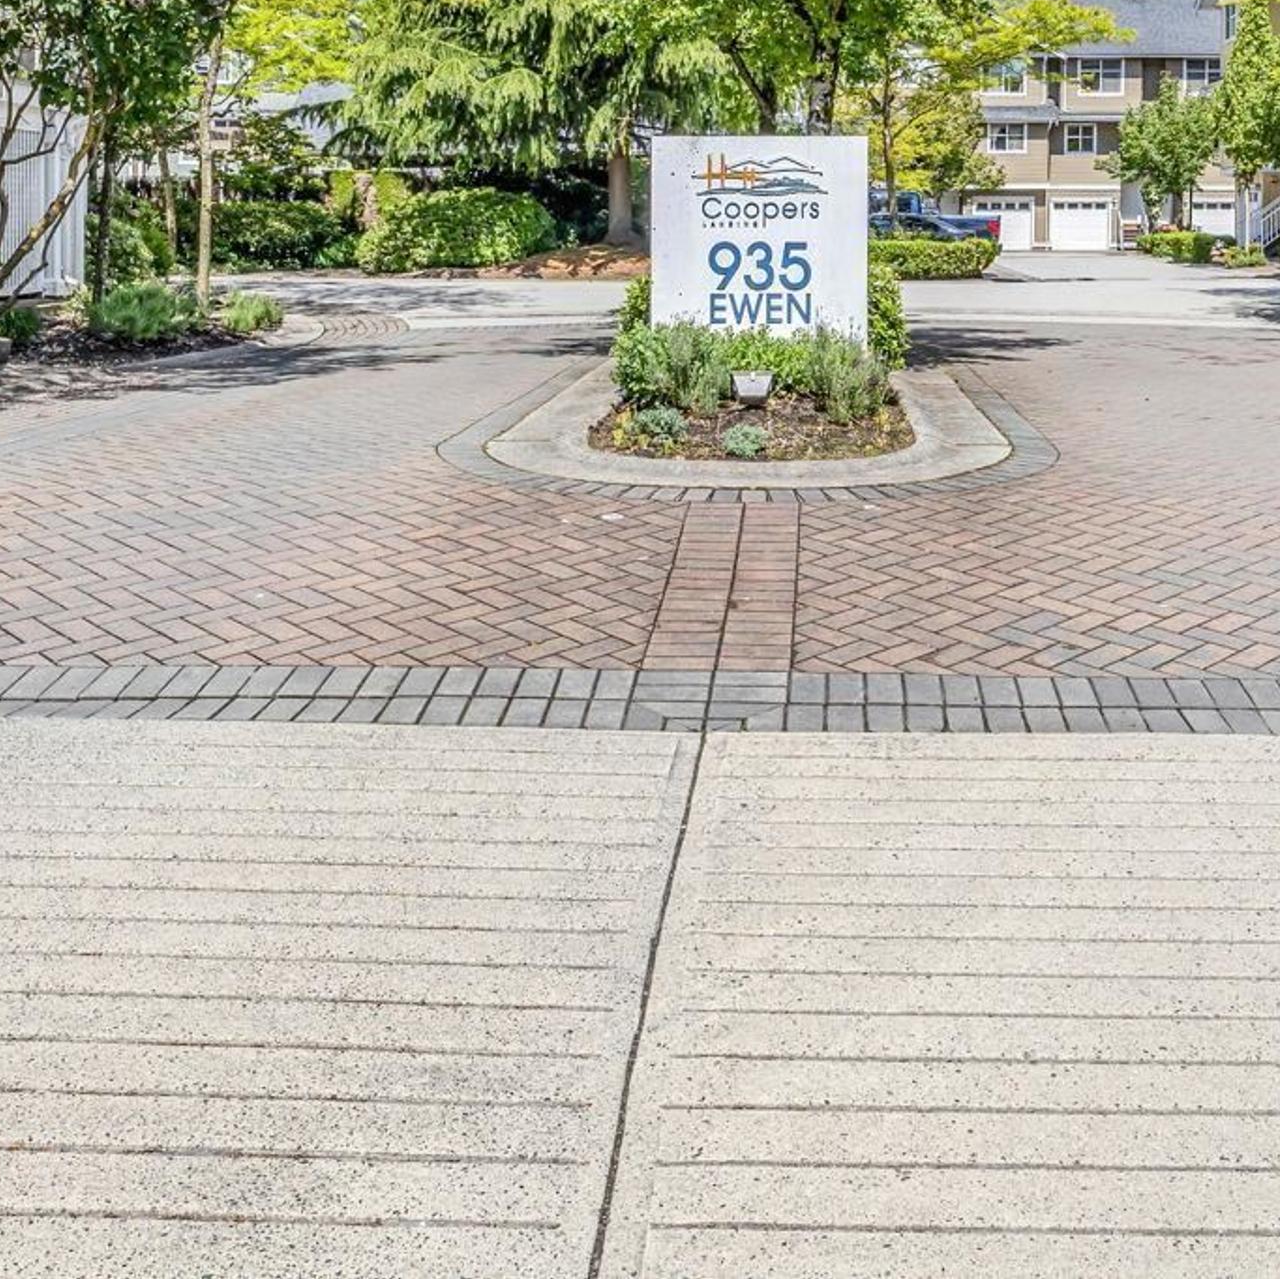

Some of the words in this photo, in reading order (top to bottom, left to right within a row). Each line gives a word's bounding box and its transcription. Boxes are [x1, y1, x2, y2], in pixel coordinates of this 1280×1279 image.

[702, 197, 820, 228] Coopers
[708, 241, 812, 291] 935
[709, 293, 811, 324] EWEN
